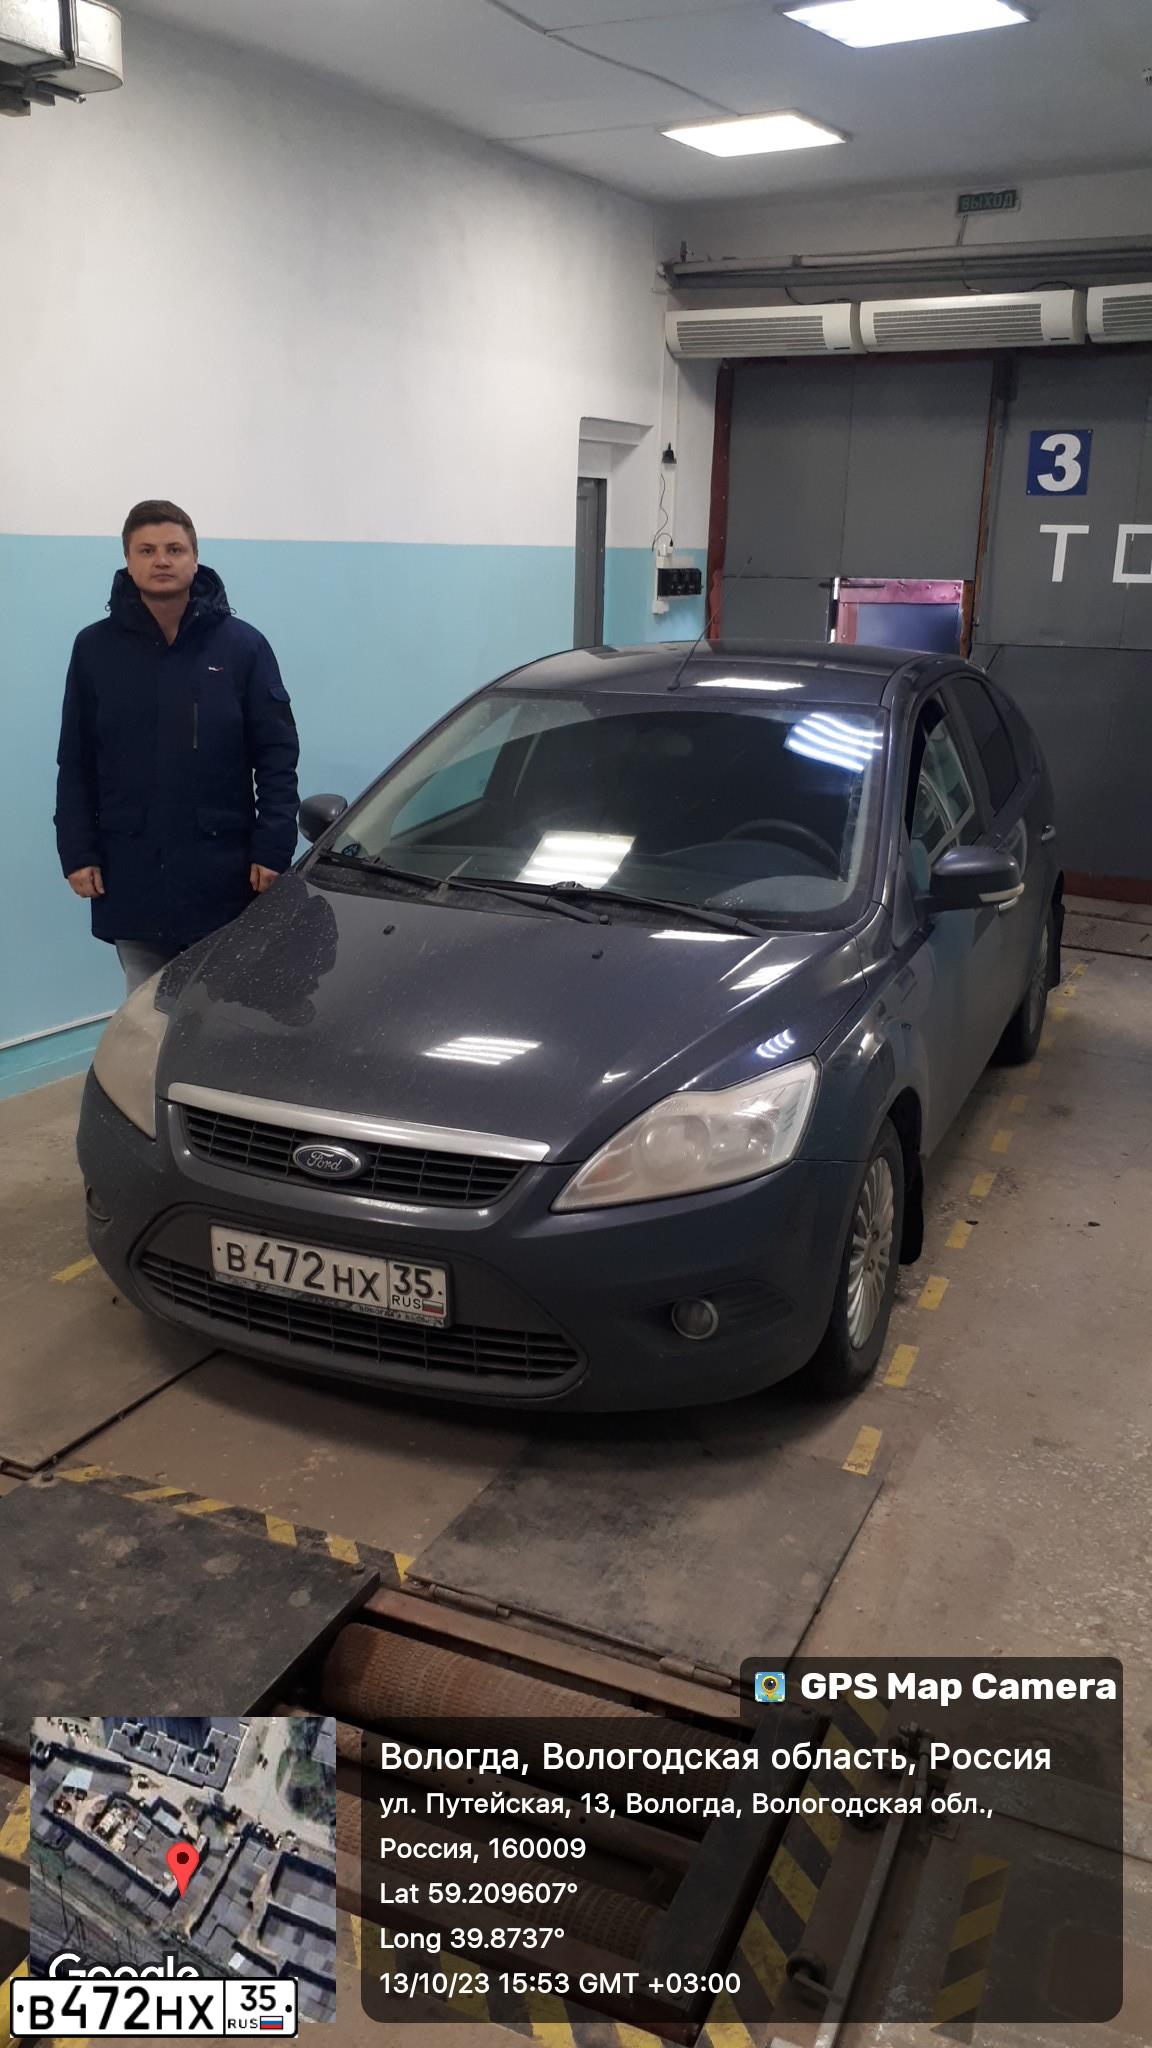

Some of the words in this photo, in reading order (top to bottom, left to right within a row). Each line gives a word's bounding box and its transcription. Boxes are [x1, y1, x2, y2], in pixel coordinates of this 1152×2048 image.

[961, 192, 1014, 210] ВЫХОД
[1037, 433, 1082, 492] 3
[306, 1150, 343, 1171] Ford
[393, 1264, 433, 1299] 35
[391, 1295, 421, 1309] RUS
